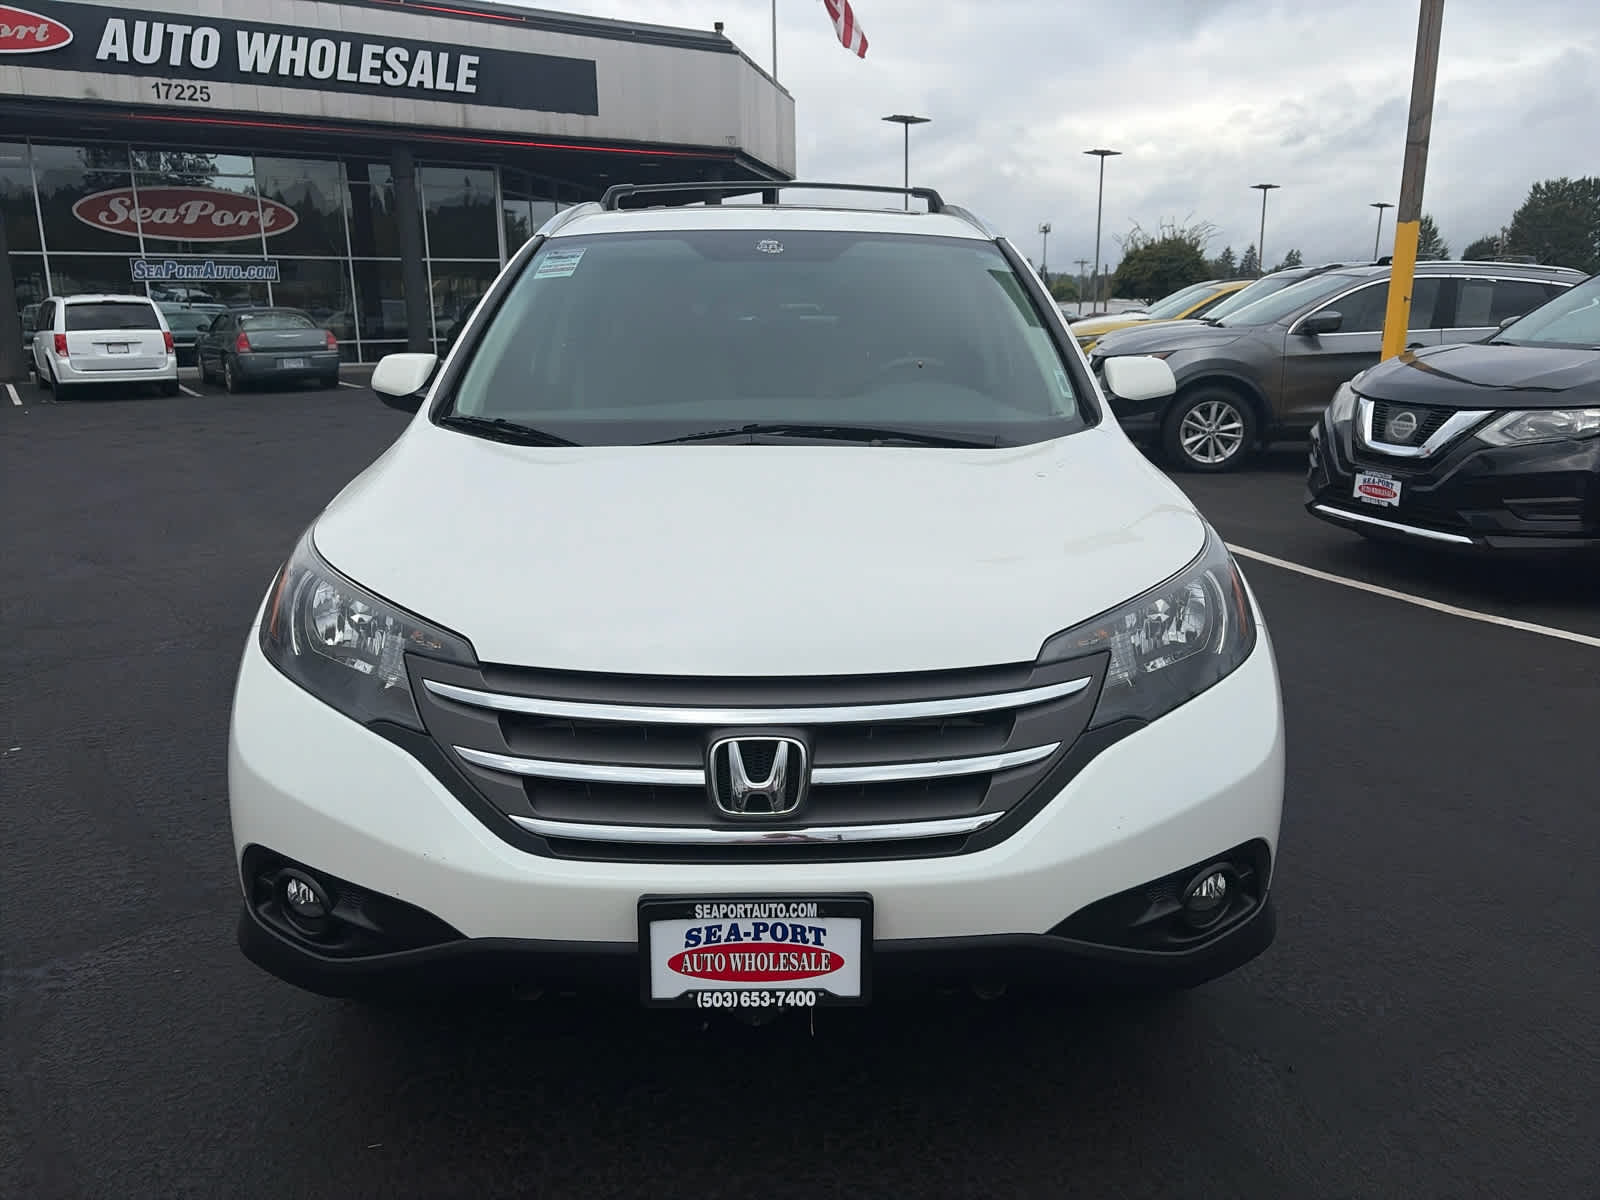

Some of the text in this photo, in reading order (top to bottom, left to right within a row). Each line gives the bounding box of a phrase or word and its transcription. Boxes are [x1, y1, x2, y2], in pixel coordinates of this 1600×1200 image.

[95, 17, 480, 93] AUTO WHOLESALE
[151, 82, 211, 102] 17225
[98, 198, 276, 228] SeaPort
[694, 903, 818, 919] SEAPORTAUTO.COM
[684, 922, 827, 948] SEA-PORT
[681, 952, 832, 973] AUTO WHOLESALE
[696, 990, 816, 1008] (503) 653-7400
